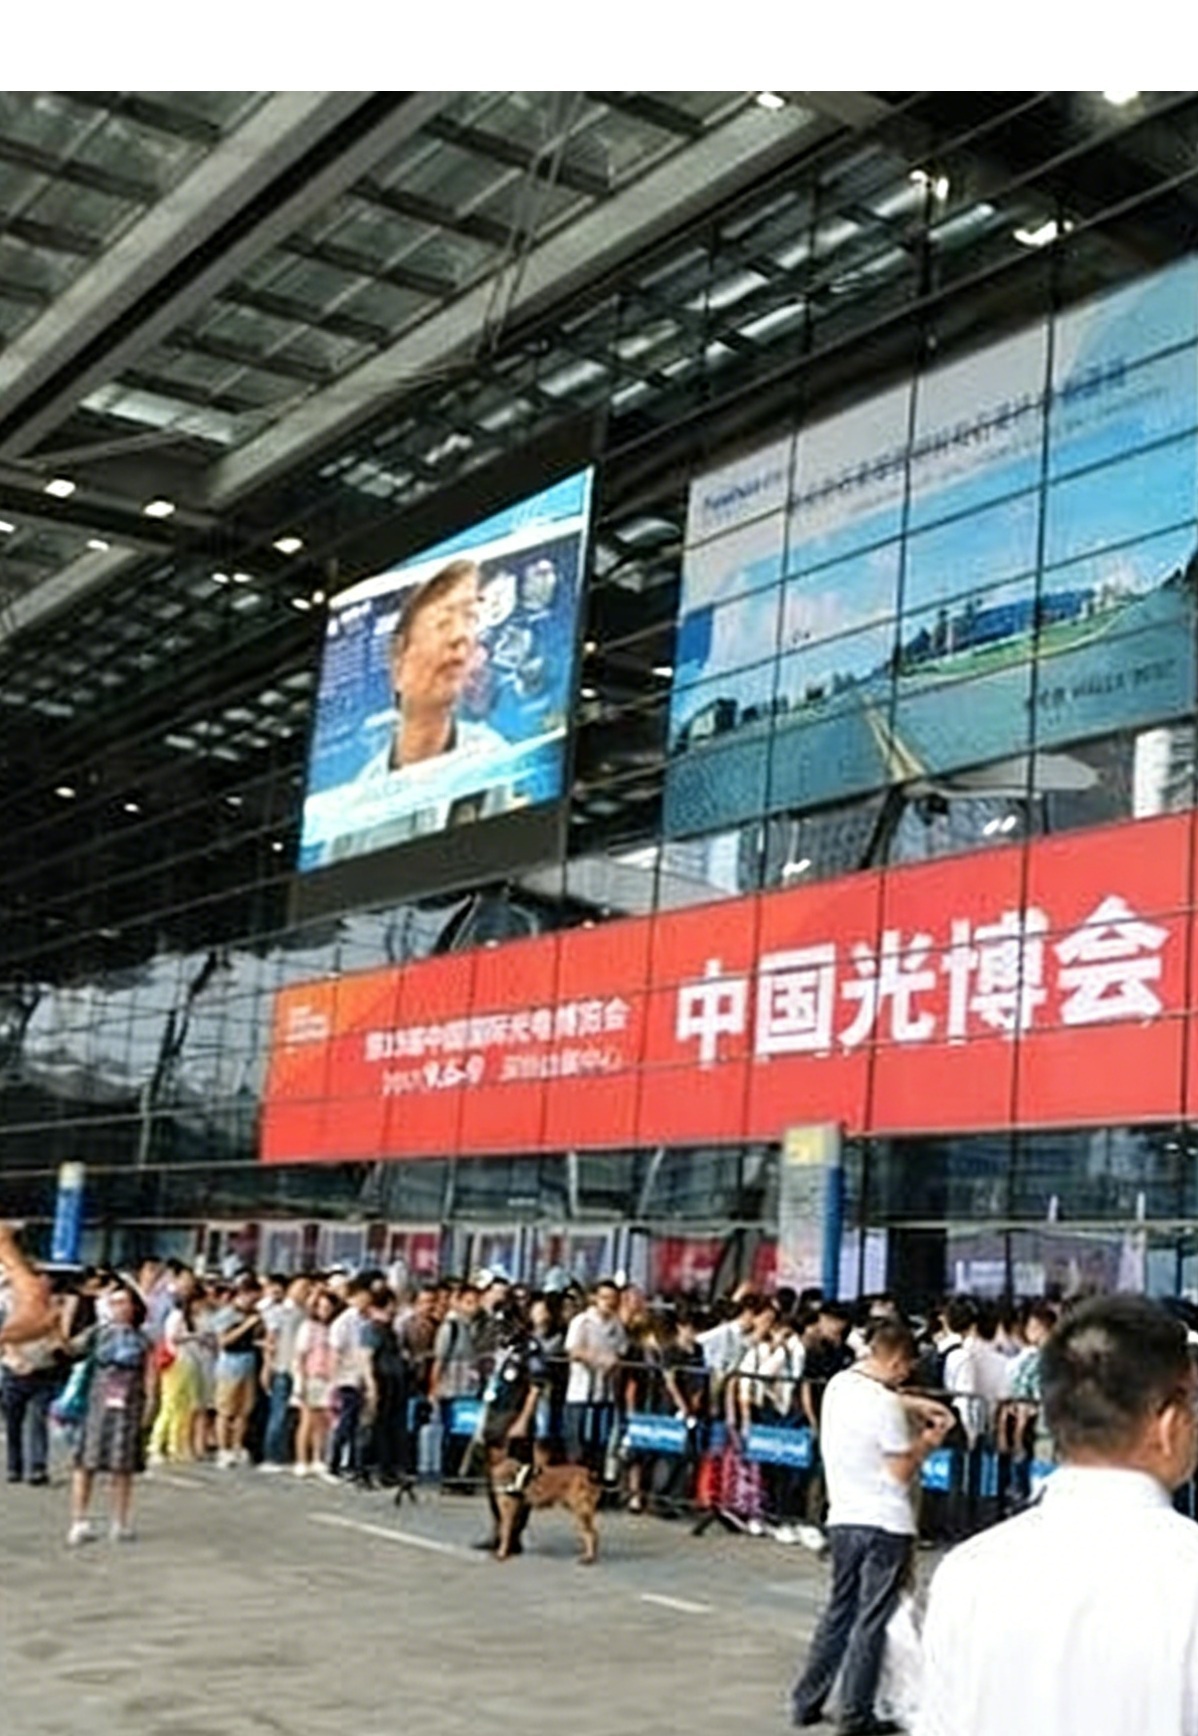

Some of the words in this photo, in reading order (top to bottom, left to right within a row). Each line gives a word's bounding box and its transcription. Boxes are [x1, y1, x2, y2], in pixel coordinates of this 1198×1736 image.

[675, 894, 1170, 1069] 中国光博会
